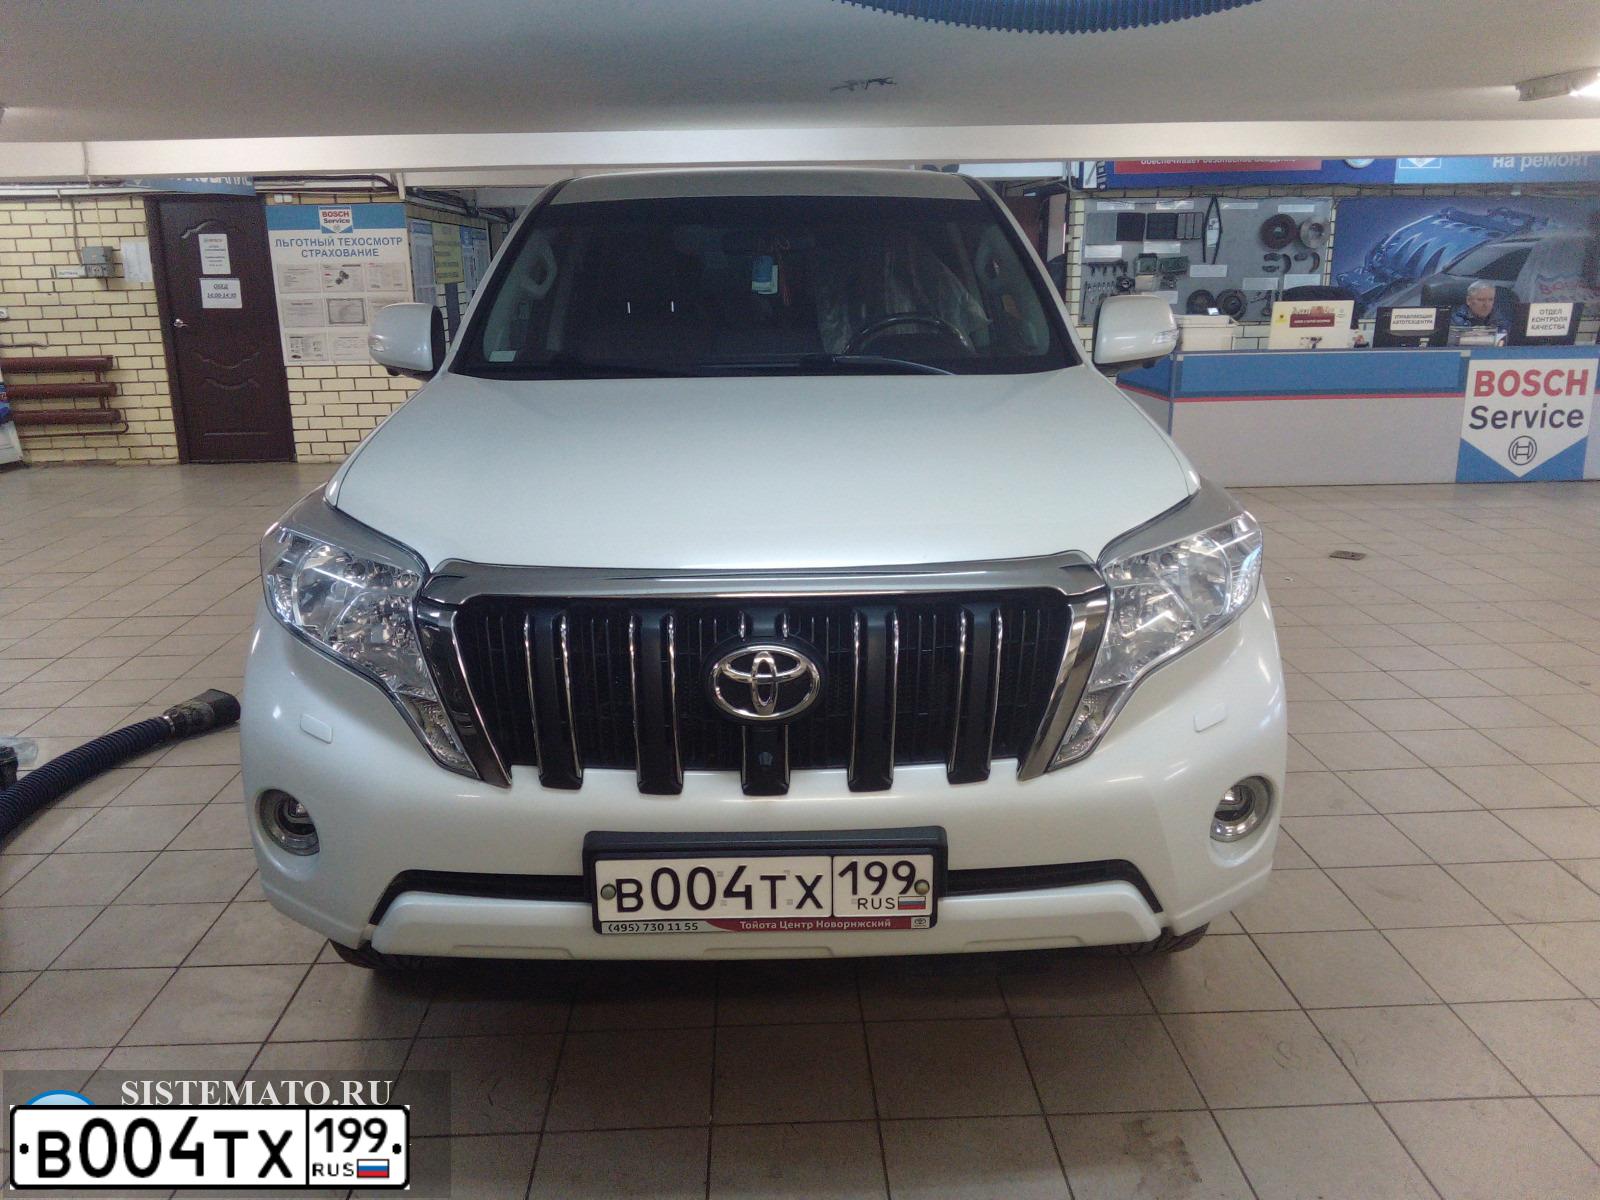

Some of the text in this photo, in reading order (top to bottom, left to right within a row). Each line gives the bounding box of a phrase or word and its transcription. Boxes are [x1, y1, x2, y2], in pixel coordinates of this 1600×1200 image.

[1520, 153, 1589, 172] ремонт
[275, 236, 403, 248] ЛЬГОТНЫЙ ТЕХОСМОТР
[301, 248, 380, 258] СТРАХОВАНИЕ
[1539, 308, 1563, 316] ОТДЕЛ
[1474, 369, 1589, 397] BOSCH
[1469, 403, 1584, 430] Service
[838, 860, 916, 895] 199
[857, 898, 895, 910] RUS
[608, 919, 891, 932] (495) 730 11 55 Тойота Центр Новорижский
